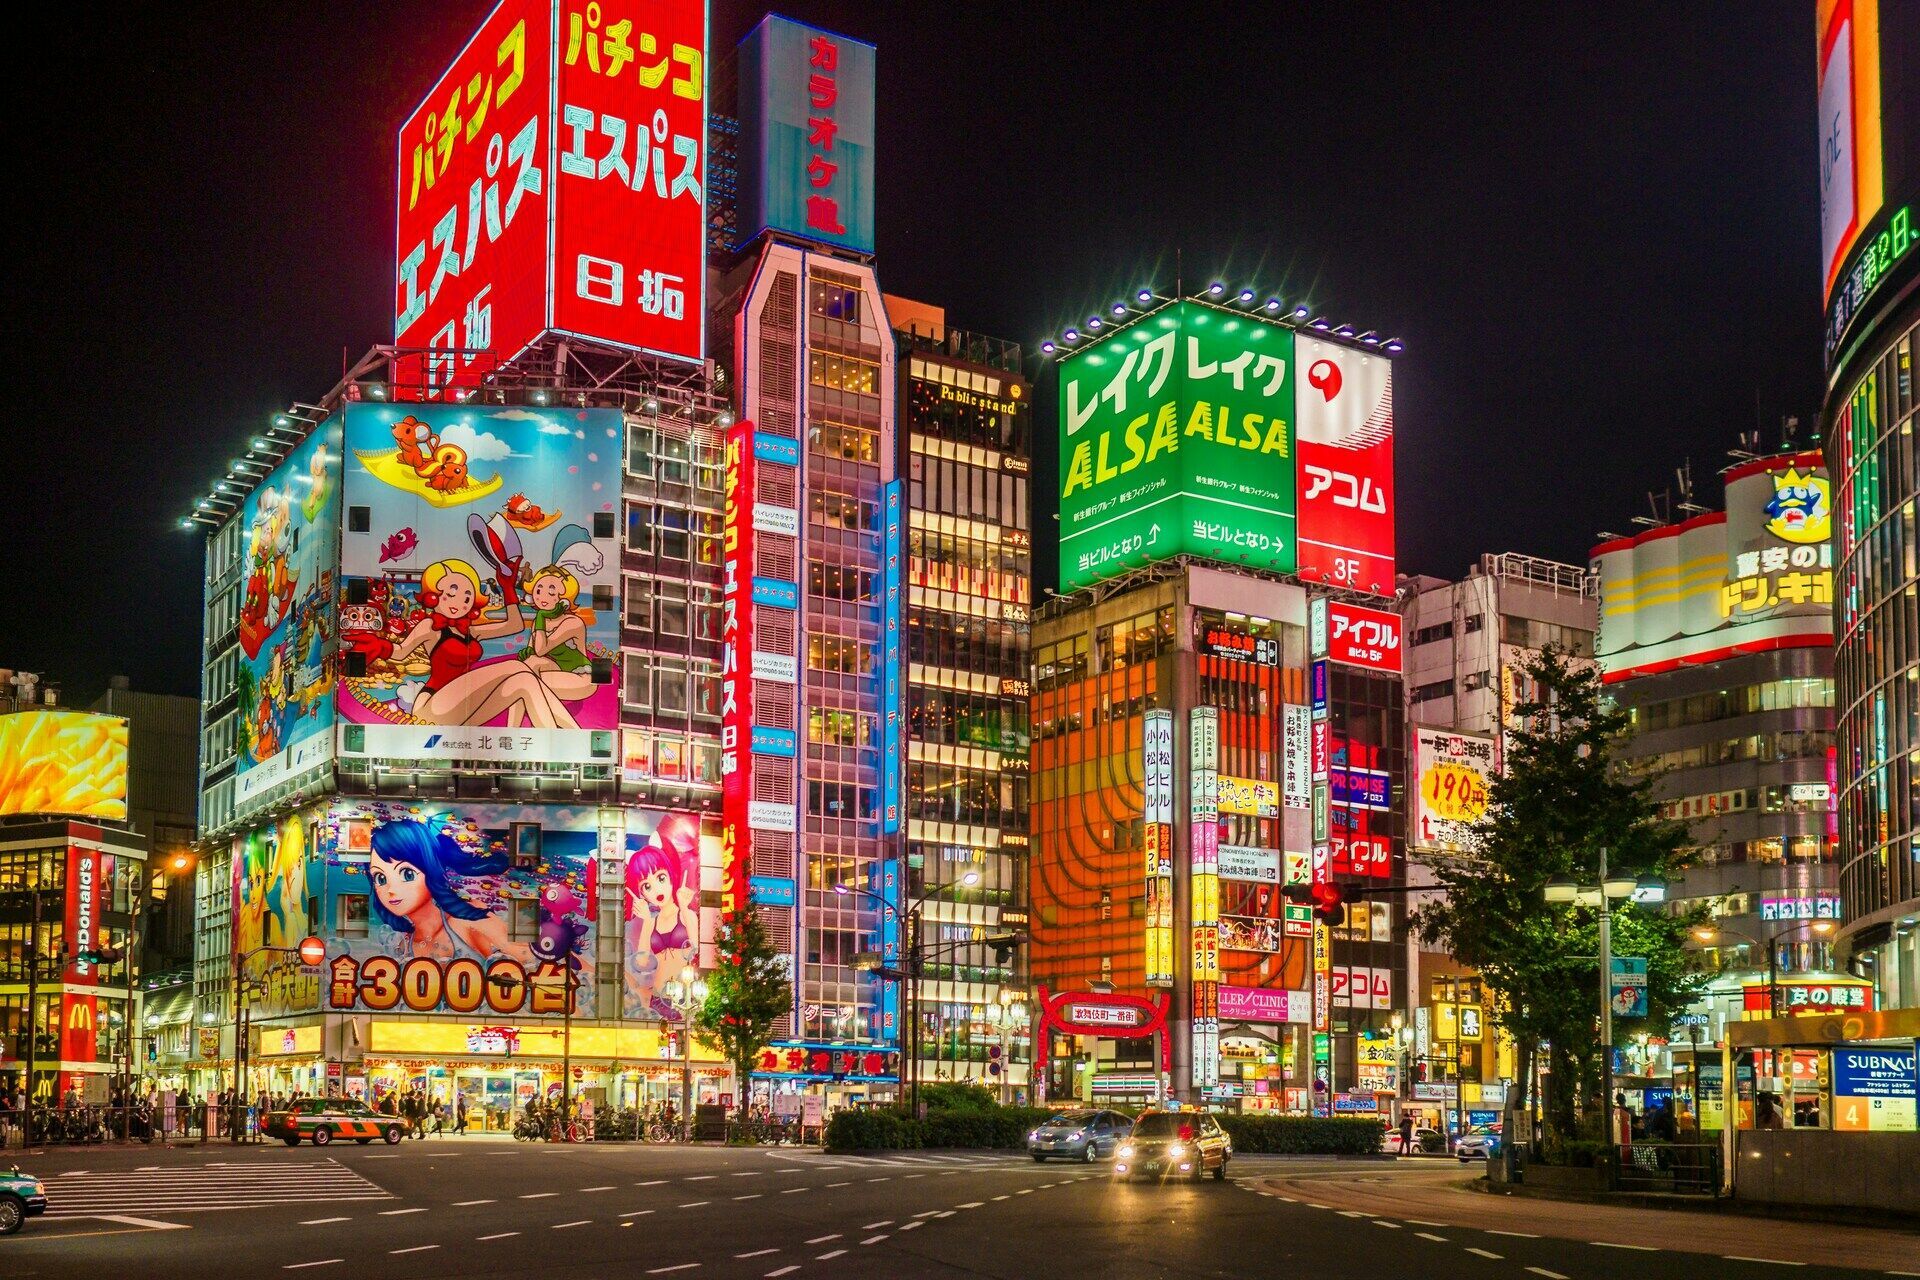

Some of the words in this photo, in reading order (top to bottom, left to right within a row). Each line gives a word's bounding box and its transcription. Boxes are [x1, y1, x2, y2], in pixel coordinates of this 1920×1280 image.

[565, 1, 702, 101] パチンコ
[409, 19, 525, 211] パチンコ
[561, 105, 701, 204] エスパス
[397, 116, 541, 338] エスパス
[1067, 331, 1176, 436] レイク
[1187, 335, 1286, 397] レイク
[942, 385, 976, 406] Public
[980, 398, 1016, 415] stand
[1184, 401, 1288, 458] ALSA
[1063, 401, 1179, 498] ALSA
[725, 437, 740, 552] パチンコ
[1073, 497, 1117, 522] 新生銀行グループ
[1119, 478, 1166, 504] 新生フィナンシャル
[1196, 476, 1236, 491] 新生銀行グループ
[1239, 484, 1279, 500] 新生フィナンシャル
[1305, 464, 1386, 514] アコム
[1078, 534, 1142, 572] 当ビルとなり
[1193, 520, 1270, 550] 当ビルとなり
[1334, 558, 1359, 581] 3F
[1331, 614, 1399, 650] アイフル
[1369, 649, 1383, 661] 5F
[478, 735, 534, 751] 北電子
[1316, 735, 1325, 771] アイフル
[1147, 729, 1156, 807] 小松ビル
[1159, 729, 1170, 807] 小松ビル
[1332, 773, 1384, 793] PROMISE
[1363, 792, 1384, 803] プロミス
[1433, 770, 1485, 808] 190円
[722, 823, 736, 913] パチンコ
[1332, 838, 1387, 863] アイフル
[1354, 863, 1364, 872] 5F
[330, 956, 359, 1008] 合計
[361, 956, 580, 1014] 3000台
[1252, 994, 1287, 1009] CLINIC
[1332, 972, 1389, 996] アコム
[804, 1004, 855, 1022] ダーツ
[1074, 1008, 1134, 1022] 歌舞伎町一番街
[1846, 1104, 1860, 1126] 4
